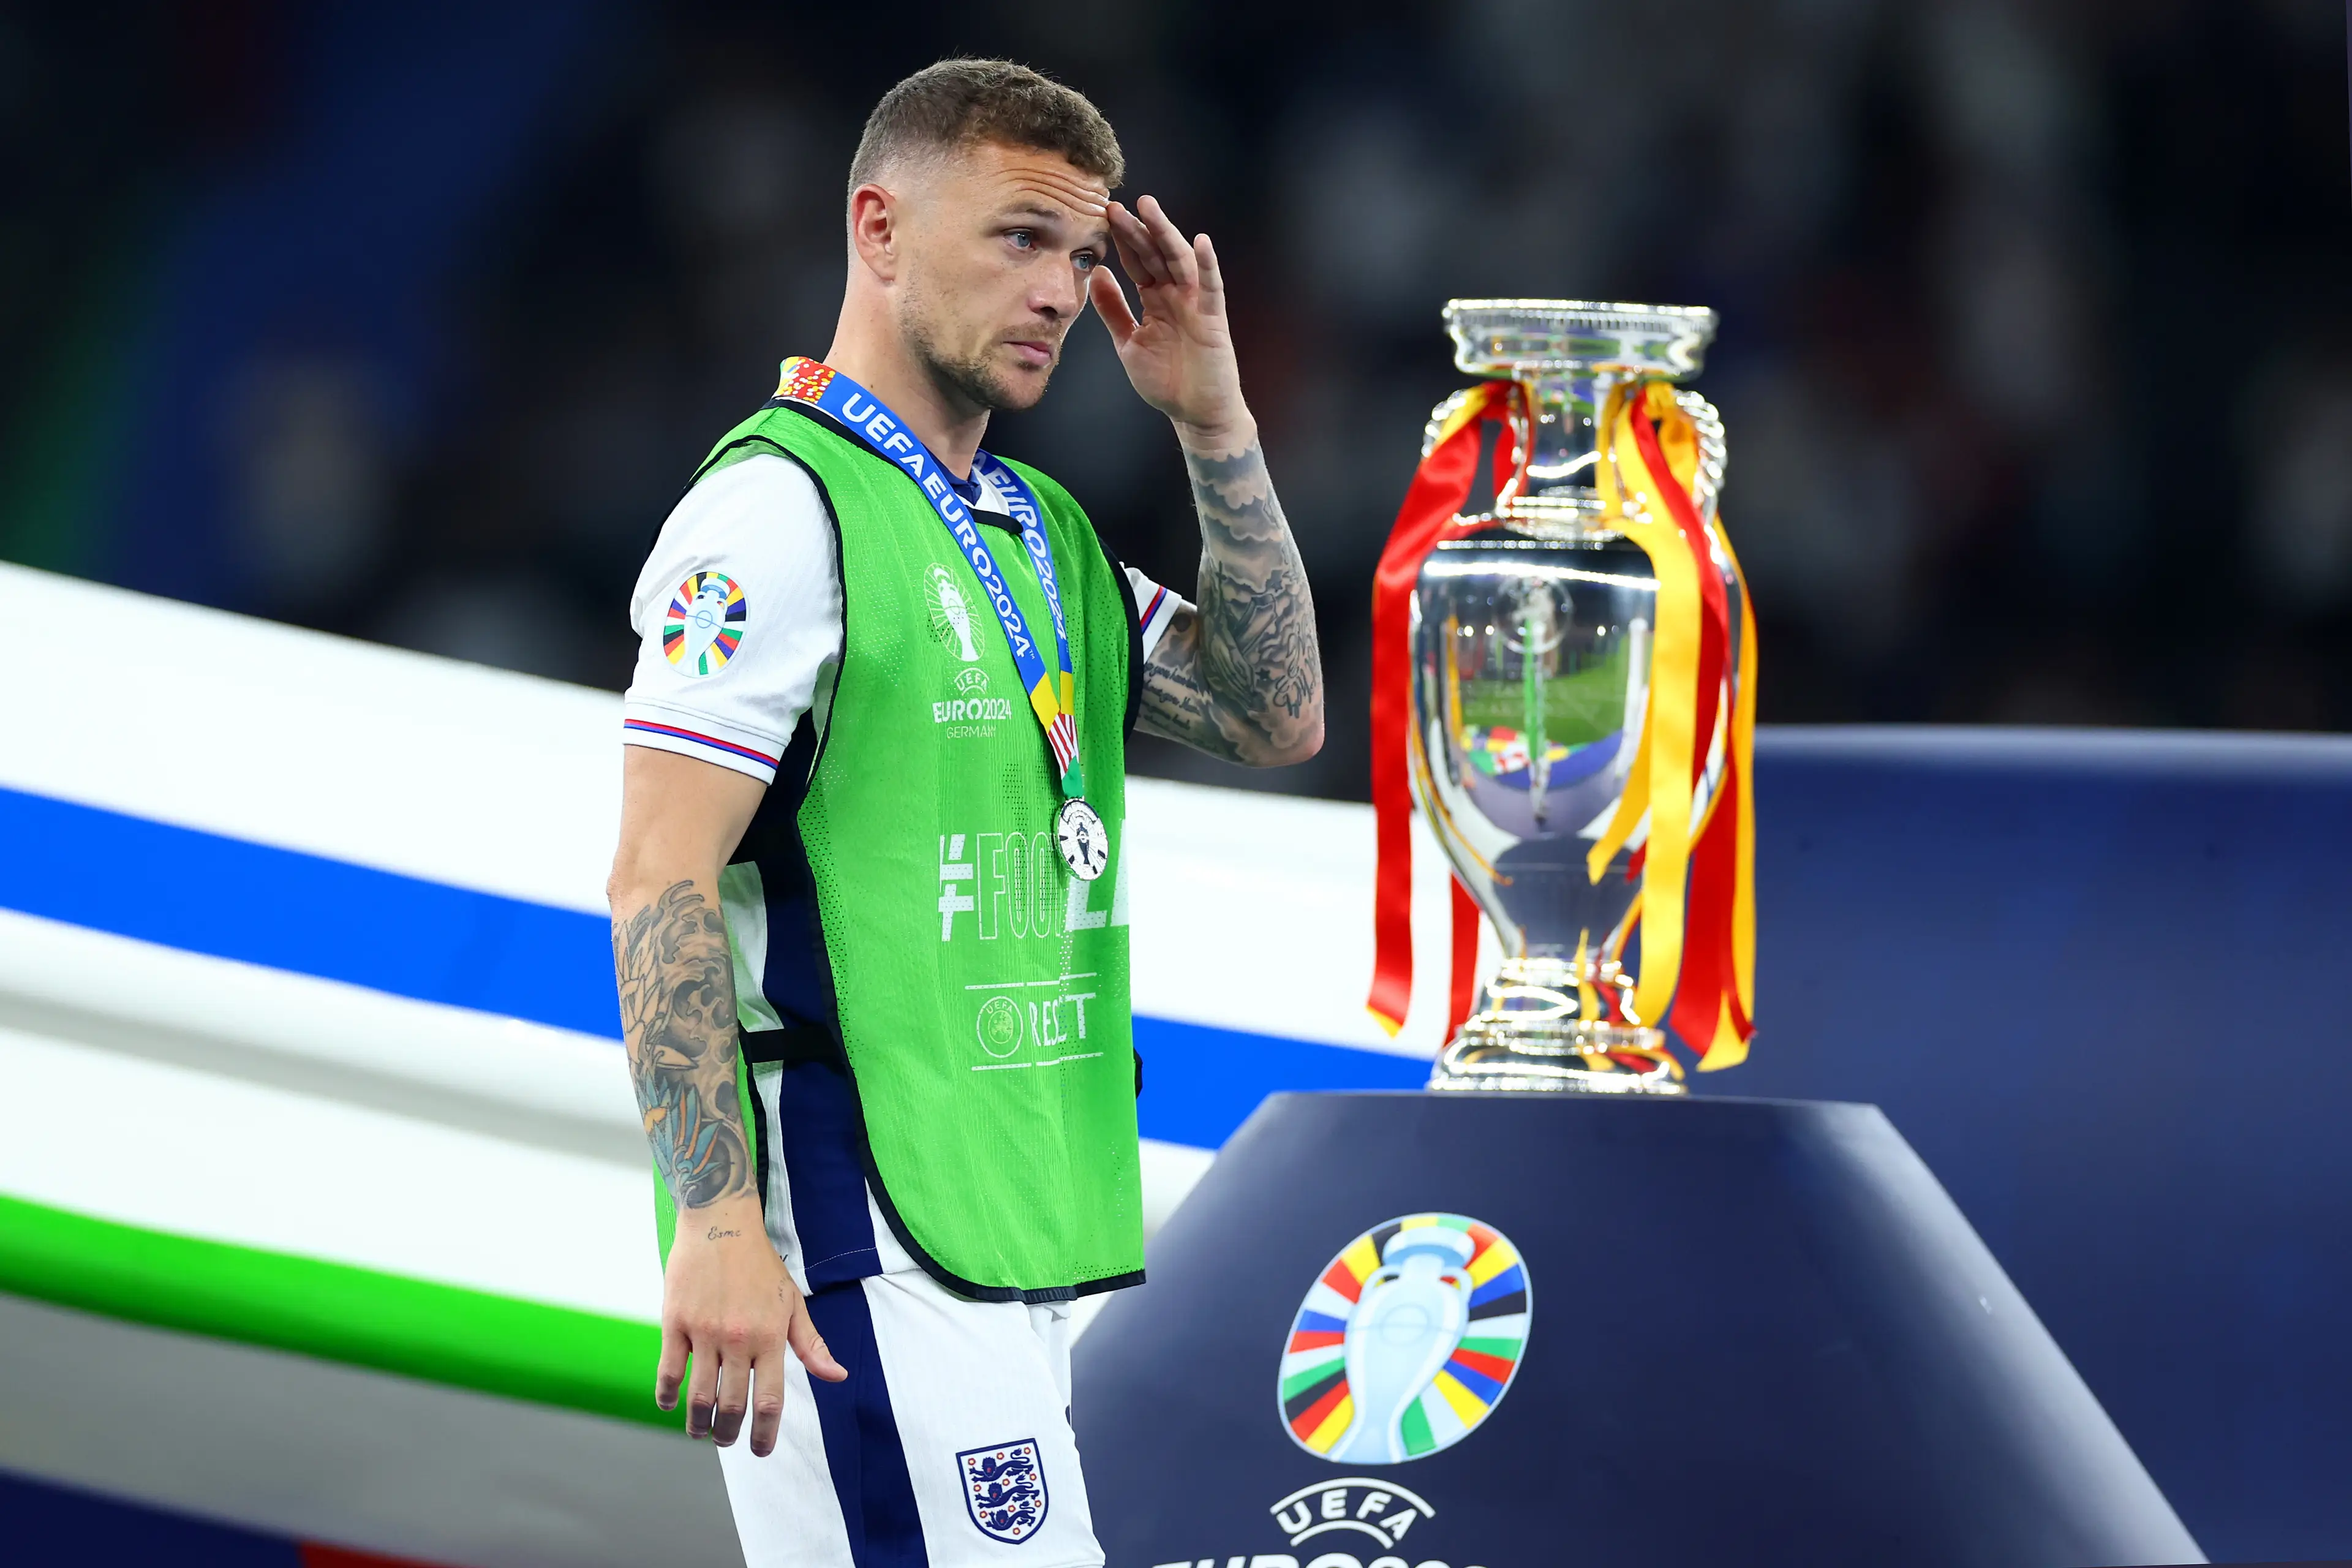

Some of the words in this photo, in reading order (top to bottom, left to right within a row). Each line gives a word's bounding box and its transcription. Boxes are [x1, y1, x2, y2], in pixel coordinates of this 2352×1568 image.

[842, 392, 924, 478] UEFA
[956, 673, 988, 691] UEFA
[932, 698, 1012, 723] EURO2024
[986, 1001, 1012, 1014] UEFA
[1276, 1488, 1417, 1540] UEFA
